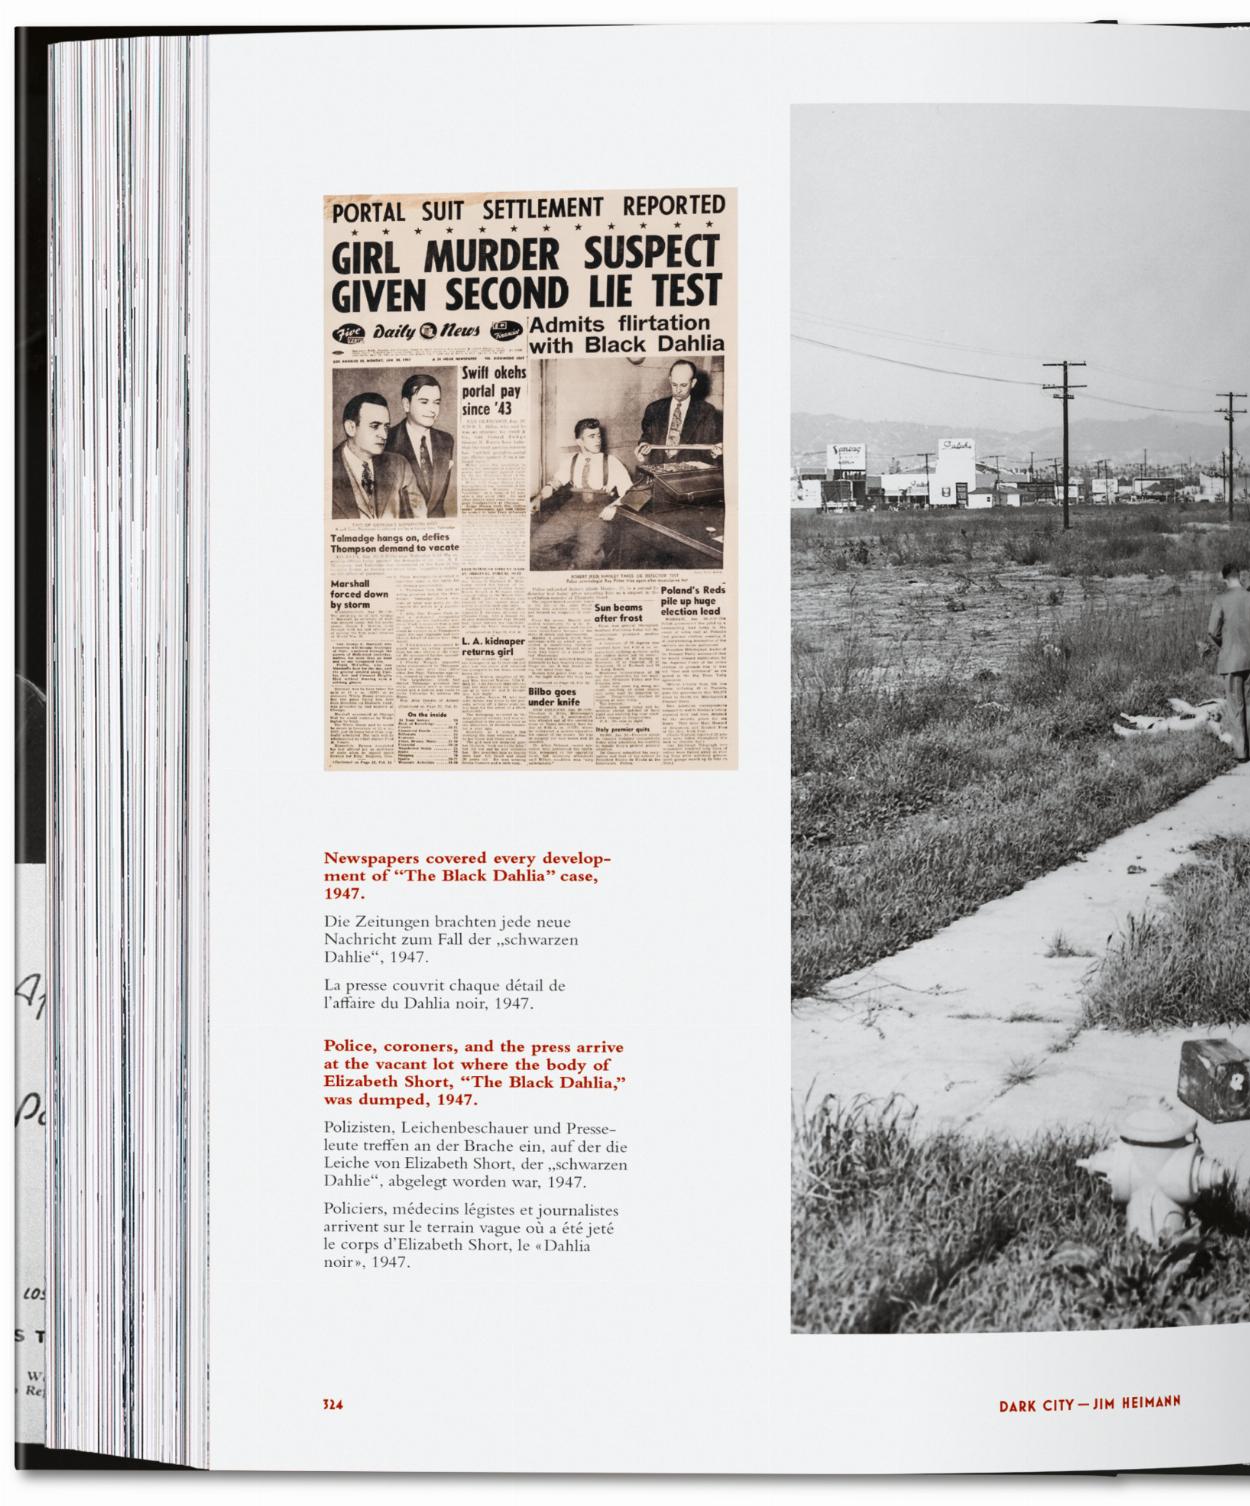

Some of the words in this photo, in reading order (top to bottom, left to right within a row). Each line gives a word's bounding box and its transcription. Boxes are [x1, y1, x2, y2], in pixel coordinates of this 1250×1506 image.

[333, 202, 405, 223] PORTAL
[422, 200, 464, 221] SUIT
[483, 197, 604, 220] SETTLEMENT
[624, 195, 725, 215] REPORTED
[332, 241, 400, 275] GIRL
[424, 237, 559, 272] MURDER
[585, 234, 720, 269] SUSPECT
[332, 279, 426, 313] GIVEN
[446, 276, 569, 311] SECOND
[590, 274, 632, 308] LIE
[652, 273, 723, 307] TEST
[529, 316, 604, 333] Admits
[618, 314, 710, 331] flirtation
[373, 324, 416, 341] Daily
[440, 323, 480, 337] News
[529, 337, 573, 354] with
[586, 336, 646, 353] Black
[659, 334, 724, 352] Dahlia
[462, 366, 488, 379] Swift
[495, 365, 526, 379] okehs
[463, 384, 495, 399] portal
[501, 387, 520, 399] pay
[462, 402, 490, 415] since
[330, 534, 374, 544] Talmadge
[377, 534, 403, 544] hangs
[422, 533, 449, 541] defies
[331, 545, 376, 555] Thompson
[379, 544, 414, 552] demand
[330, 590, 360, 598] forced
[364, 590, 388, 598] down
[703, 586, 725, 594] Reds
[331, 601, 341, 611] by
[595, 604, 611, 612] Sun
[661, 597, 677, 607] pile
[680, 599, 691, 607] up
[694, 597, 716, 607] huge
[594, 614, 617, 622] after
[620, 614, 643, 622] frost
[661, 607, 696, 615] election
[701, 607, 720, 615] lead
[462, 637, 470, 645] L.
[473, 637, 482, 645] A.
[485, 637, 525, 647] kidnaper
[497, 648, 513, 658] girl
[529, 687, 551, 695] Bilbo
[528, 698, 555, 706] under
[557, 698, 580, 706] knife
[324, 852, 419, 868] Newspapers
[426, 851, 486, 864] covered
[494, 856, 536, 867] every
[543, 852, 611, 868] develop-
[325, 872, 365, 881] ment
[372, 869, 390, 881] of
[443, 869, 486, 881] Black
[560, 874, 598, 884] case,
[326, 888, 364, 899] 1947.
[325, 915, 350, 927] Die
[356, 915, 429, 931] Zeitungen
[435, 915, 496, 927] brachten
[499, 915, 531, 931] jede
[537, 920, 571, 928] neue
[392, 951, 428, 963] 1947.
[325, 979, 340, 990] La
[346, 983, 387, 994] presse
[393, 979, 444, 991] couvrit
[450, 978, 499, 995] chaque
[506, 979, 543, 991] détail
[549, 979, 565, 991] de
[381, 996, 398, 1009] du
[405, 997, 449, 1009] Dahlia
[456, 997, 488, 1010] noir,
[496, 997, 533, 1009] 1947.
[324, 1039, 377, 1054] Police,
[384, 1044, 458, 1054] coroners,
[465, 1040, 493, 1052] and
[501, 1040, 524, 1052] the
[532, 1045, 570, 1056] press
[577, 1041, 623, 1053] arrive
[324, 1060, 338, 1069] at
[345, 1057, 369, 1069] the
[376, 1060, 426, 1069] vacant
[434, 1058, 454, 1070] lot
[461, 1058, 508, 1070] where
[515, 1058, 539, 1070] the
[547, 1058, 586, 1074] body
[593, 1058, 611, 1071] of
[324, 1075, 397, 1087] Elizabeth
[405, 1075, 453, 1090] Short,
[509, 1076, 553, 1088] Black
[324, 1097, 352, 1105] was
[359, 1093, 430, 1109] dumped,
[438, 1094, 477, 1105] 1947.
[325, 1120, 395, 1133] Polizisten,
[402, 1121, 528, 1134] Leichenbeschauer
[534, 1122, 560, 1134] und
[567, 1122, 616, 1134] Presse-
[389, 1174, 447, 1190] abgelegt
[453, 1175, 506, 1187] worden
[512, 1180, 541, 1189] war,
[550, 1176, 586, 1188] 1947.
[325, 1202, 387, 1216] Policiers,
[393, 1202, 459, 1215] médecins
[465, 1203, 515, 1219] légistes
[520, 1207, 533, 1215] et
[536, 1204, 618, 1219] journalistes
[324, 1237, 335, 1249] le
[341, 1242, 379, 1254] corps
[469, 1238, 512, 1252] Short,
[518, 1239, 530, 1251] le
[374, 1256, 410, 1268] 1947.
[323, 1399, 343, 1409] 324
[1000, 1400, 1036, 1412] DARK
[1043, 1399, 1074, 1411] CITY
[1093, 1398, 1114, 1409] JIM
[1123, 1395, 1180, 1408] HEIMANN
